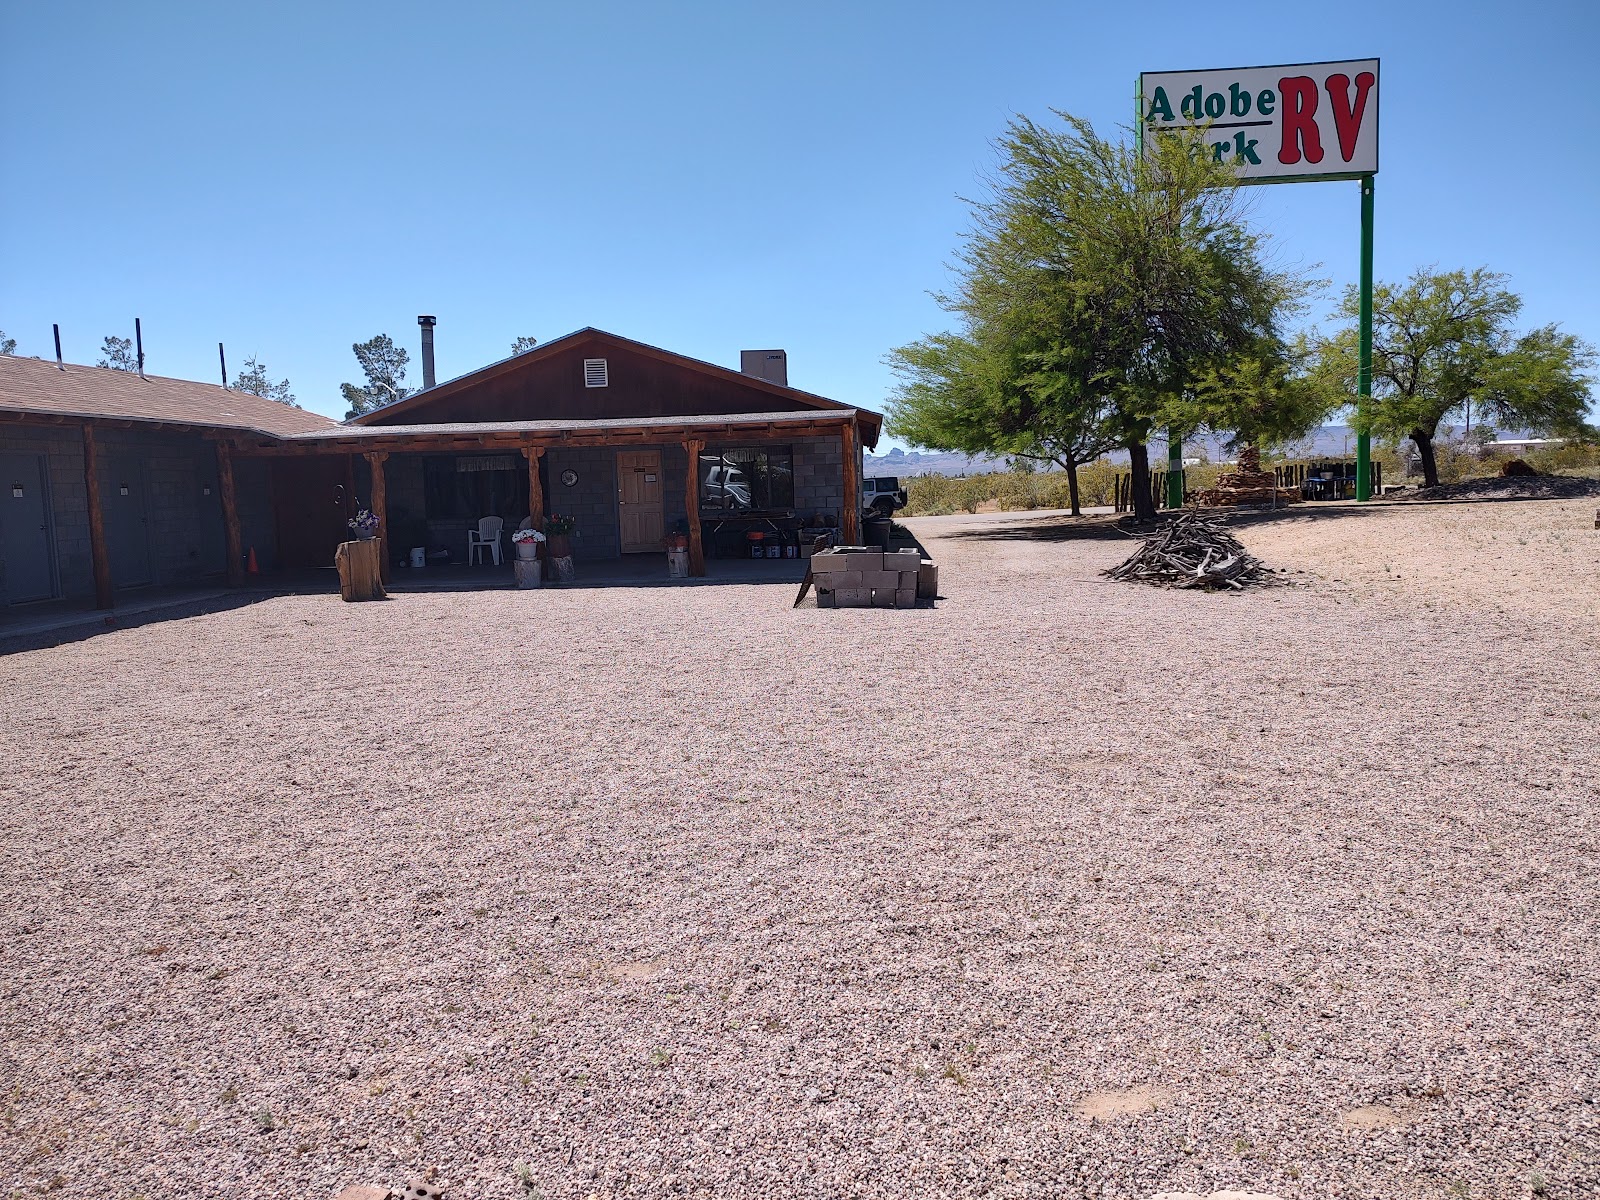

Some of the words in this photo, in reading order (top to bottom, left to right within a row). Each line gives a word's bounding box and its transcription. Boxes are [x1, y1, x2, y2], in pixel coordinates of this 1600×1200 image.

[1146, 82, 1276, 121] Adobe
[1277, 71, 1375, 164] RV
[1168, 130, 1262, 165] rk
